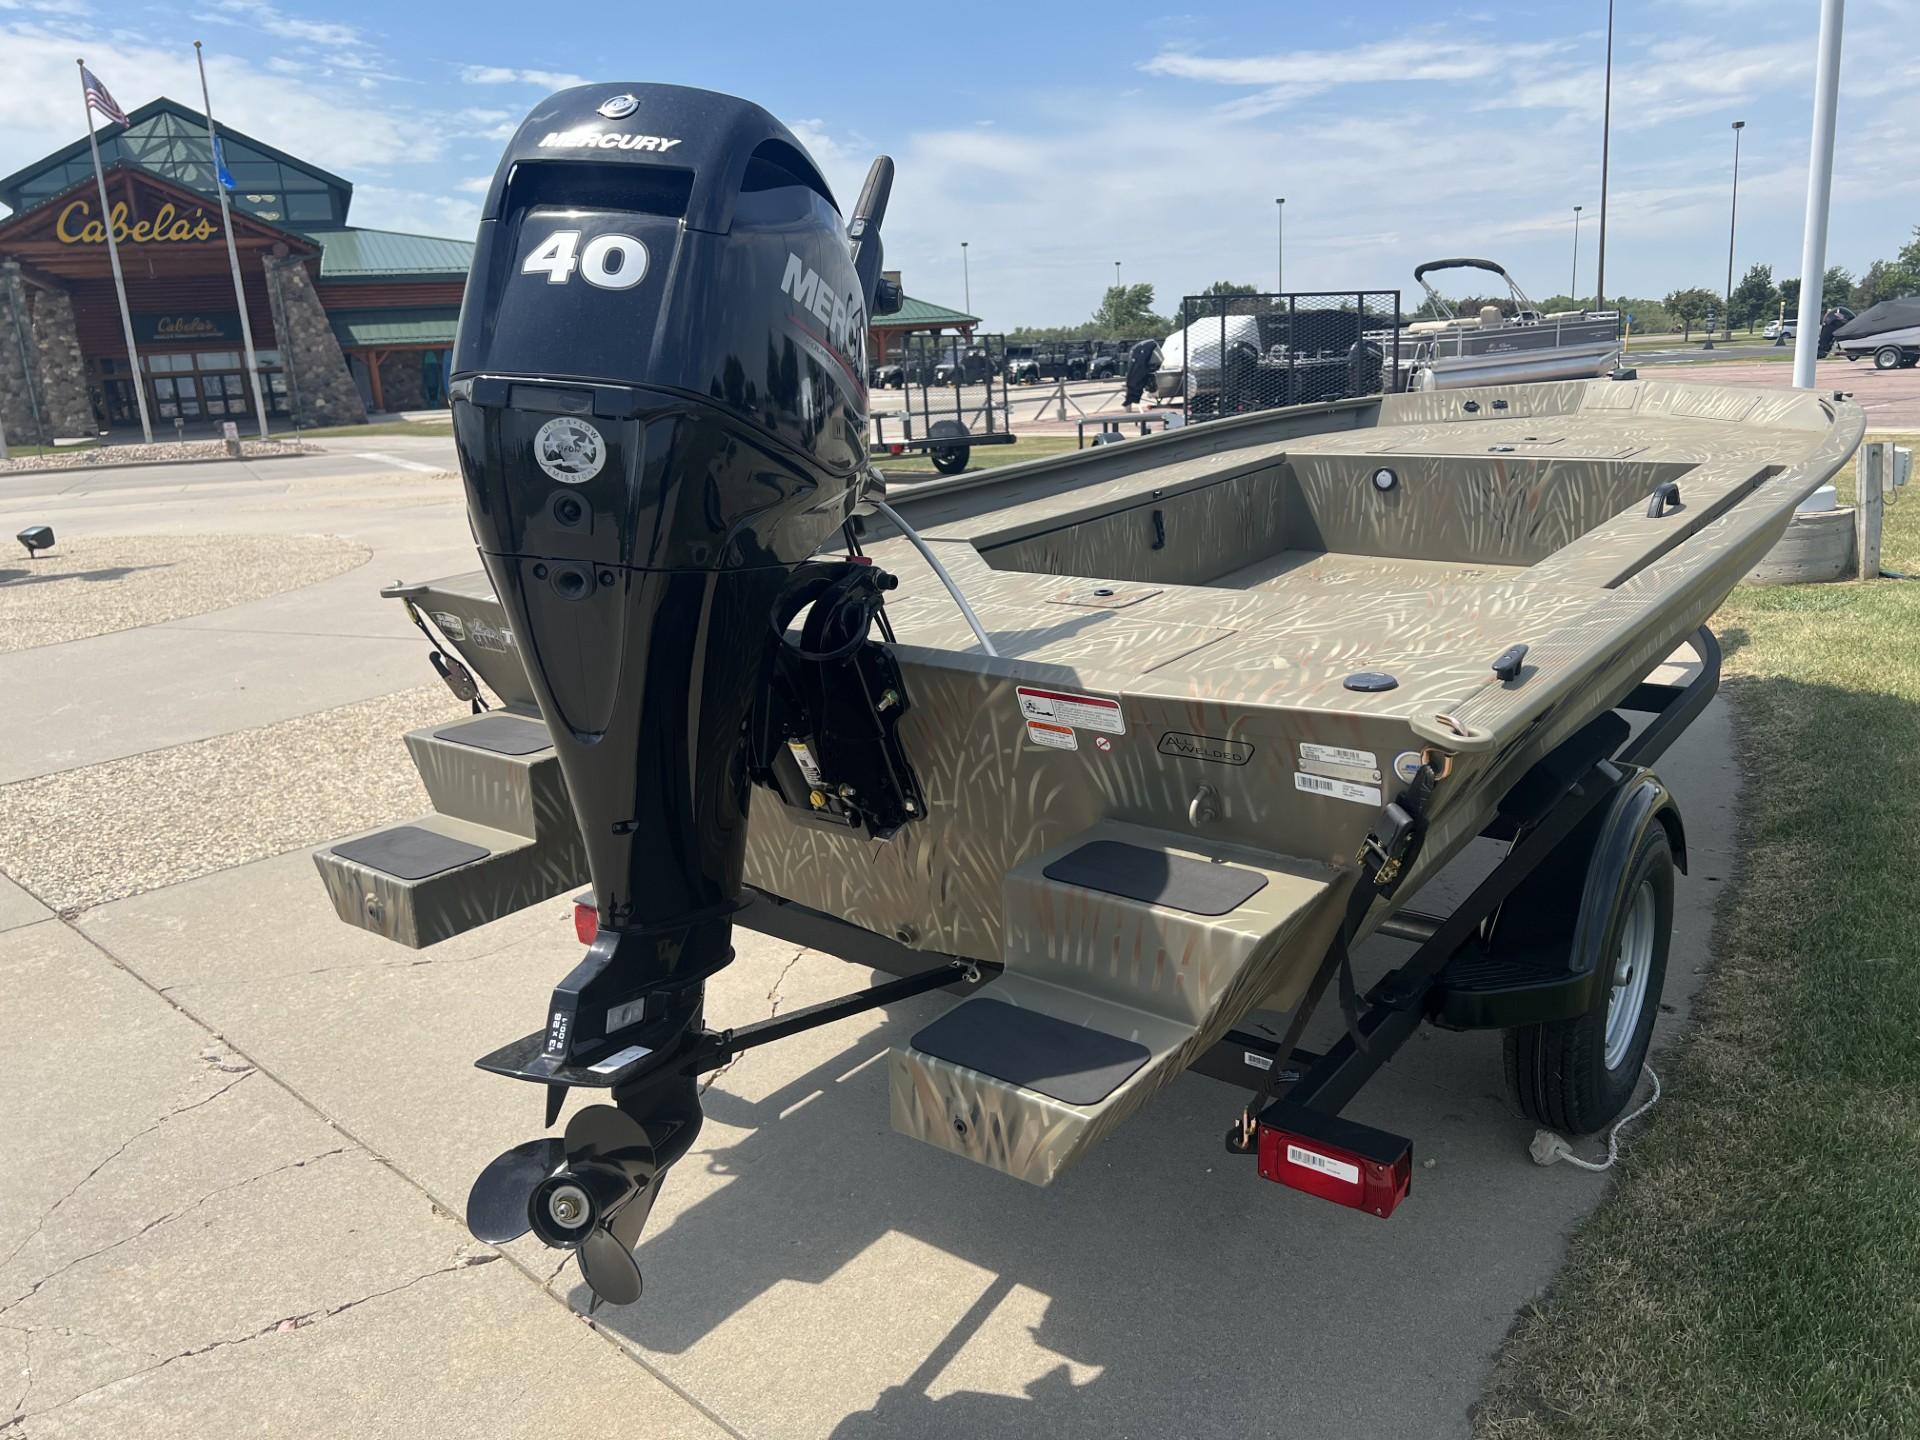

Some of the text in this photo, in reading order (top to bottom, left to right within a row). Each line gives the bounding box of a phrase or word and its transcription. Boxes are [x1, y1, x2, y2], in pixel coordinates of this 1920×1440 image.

[538, 132, 682, 152] MERCURY
[56, 200, 218, 244] Cabela's
[521, 230, 650, 290] 40
[1174, 741, 1242, 761] WELDED
[548, 1039, 557, 1052] 13
